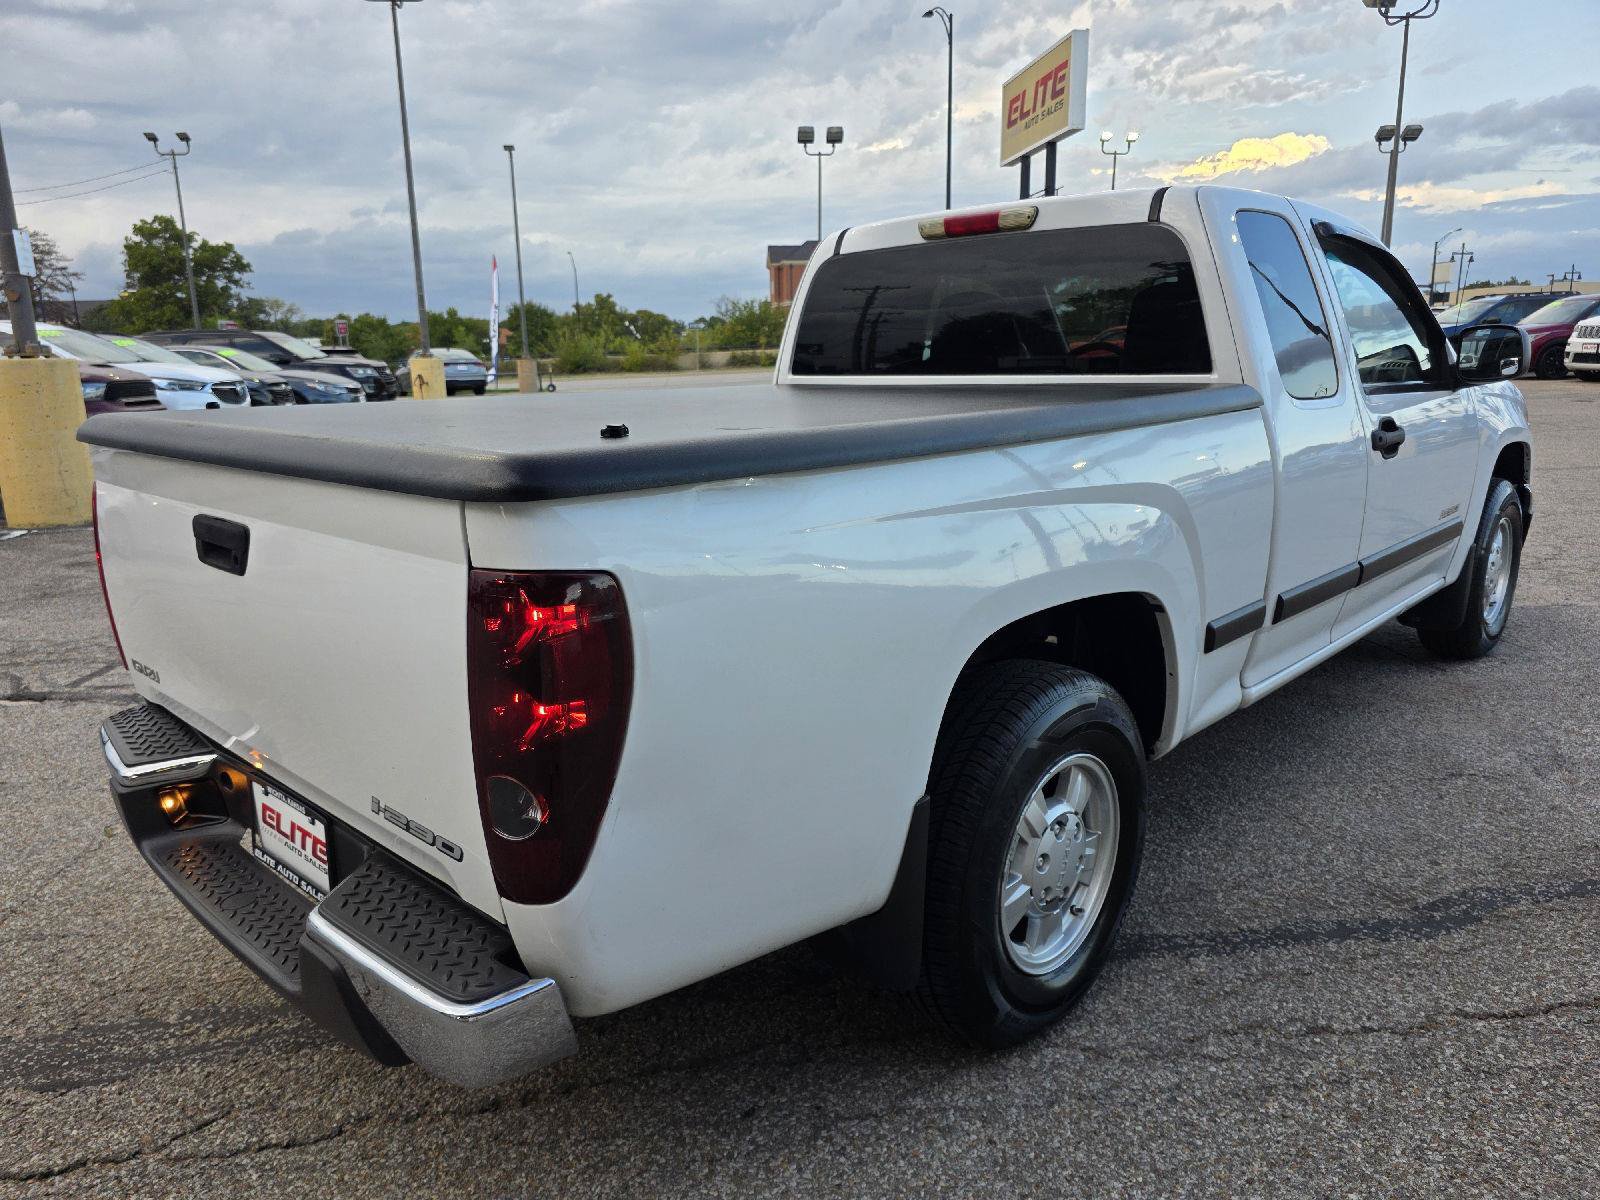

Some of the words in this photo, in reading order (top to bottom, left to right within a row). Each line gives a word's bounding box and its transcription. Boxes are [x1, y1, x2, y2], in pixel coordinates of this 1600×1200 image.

[1007, 60, 1069, 129] ELITE
[1024, 116, 1039, 129] AUTO
[1040, 99, 1064, 120] SALES
[262, 802, 328, 865] ELITE
[284, 841, 303, 858] AUTO
[304, 854, 328, 875] SALES
[254, 848, 276, 868] ELITE
[277, 864, 299, 885] AUTO
[301, 880, 325, 902] SALE
